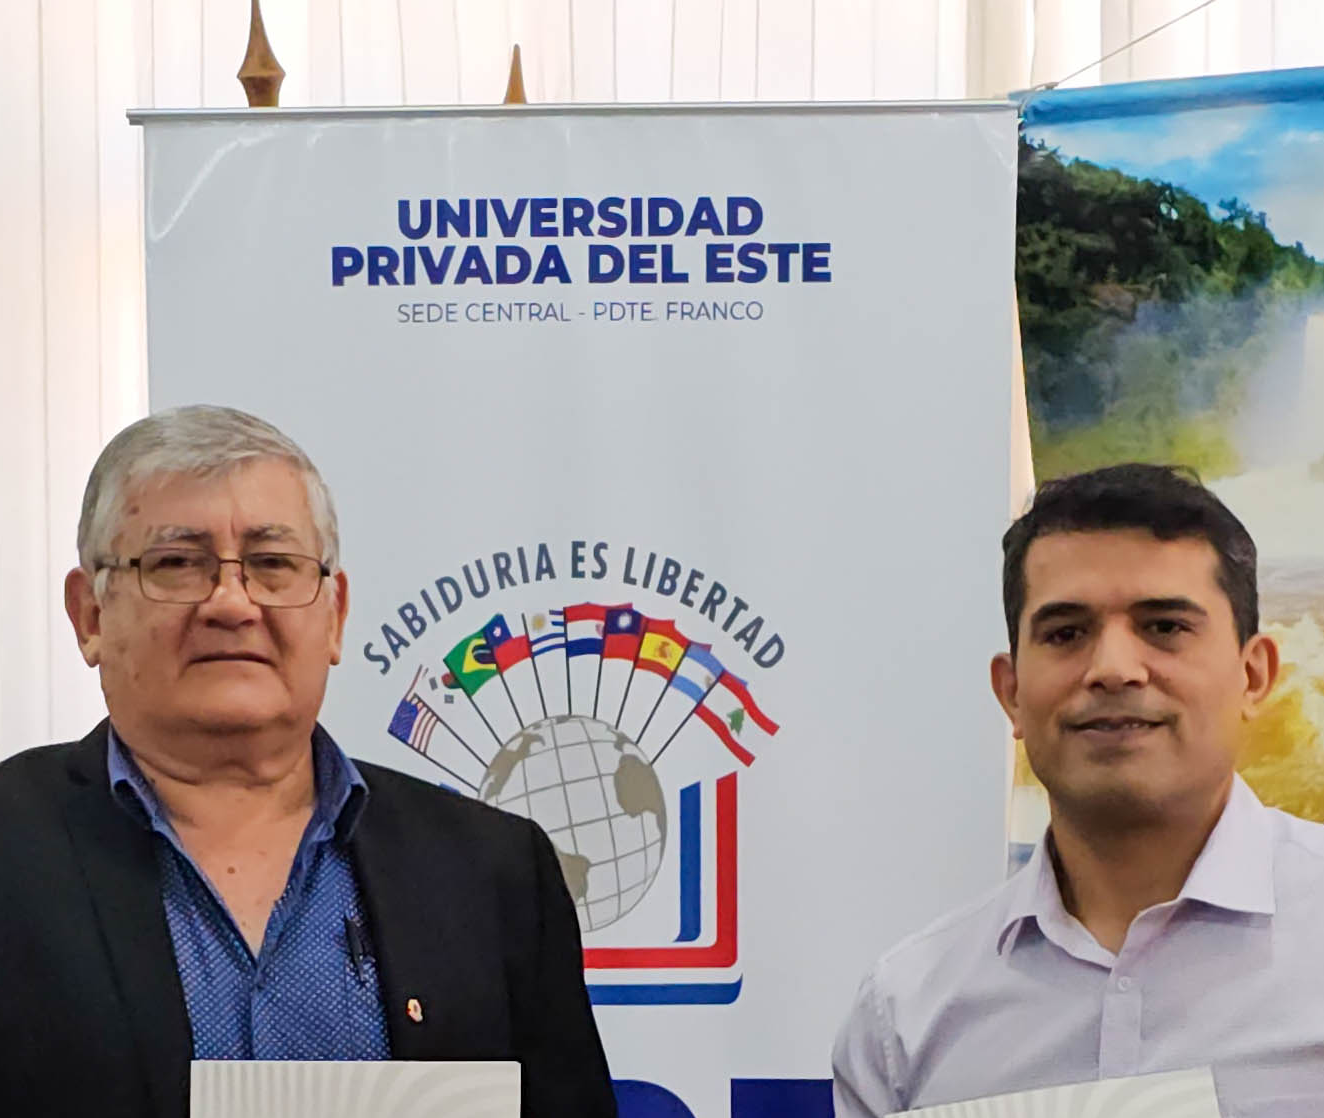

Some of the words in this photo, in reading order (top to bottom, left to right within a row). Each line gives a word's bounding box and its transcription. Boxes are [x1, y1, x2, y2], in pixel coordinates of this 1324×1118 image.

[398, 196, 764, 240] UNIVERSIDAD
[331, 244, 573, 287] PRIVADA
[587, 243, 690, 285] DEL
[705, 242, 832, 284] ESTE
[397, 303, 458, 324] SEDE
[465, 302, 572, 323] CENTRAL
[665, 301, 764, 321] FRANCO
[363, 542, 557, 676] SABIDURIA
[571, 541, 609, 580] ES
[623, 546, 785, 669] LIBERTAD
